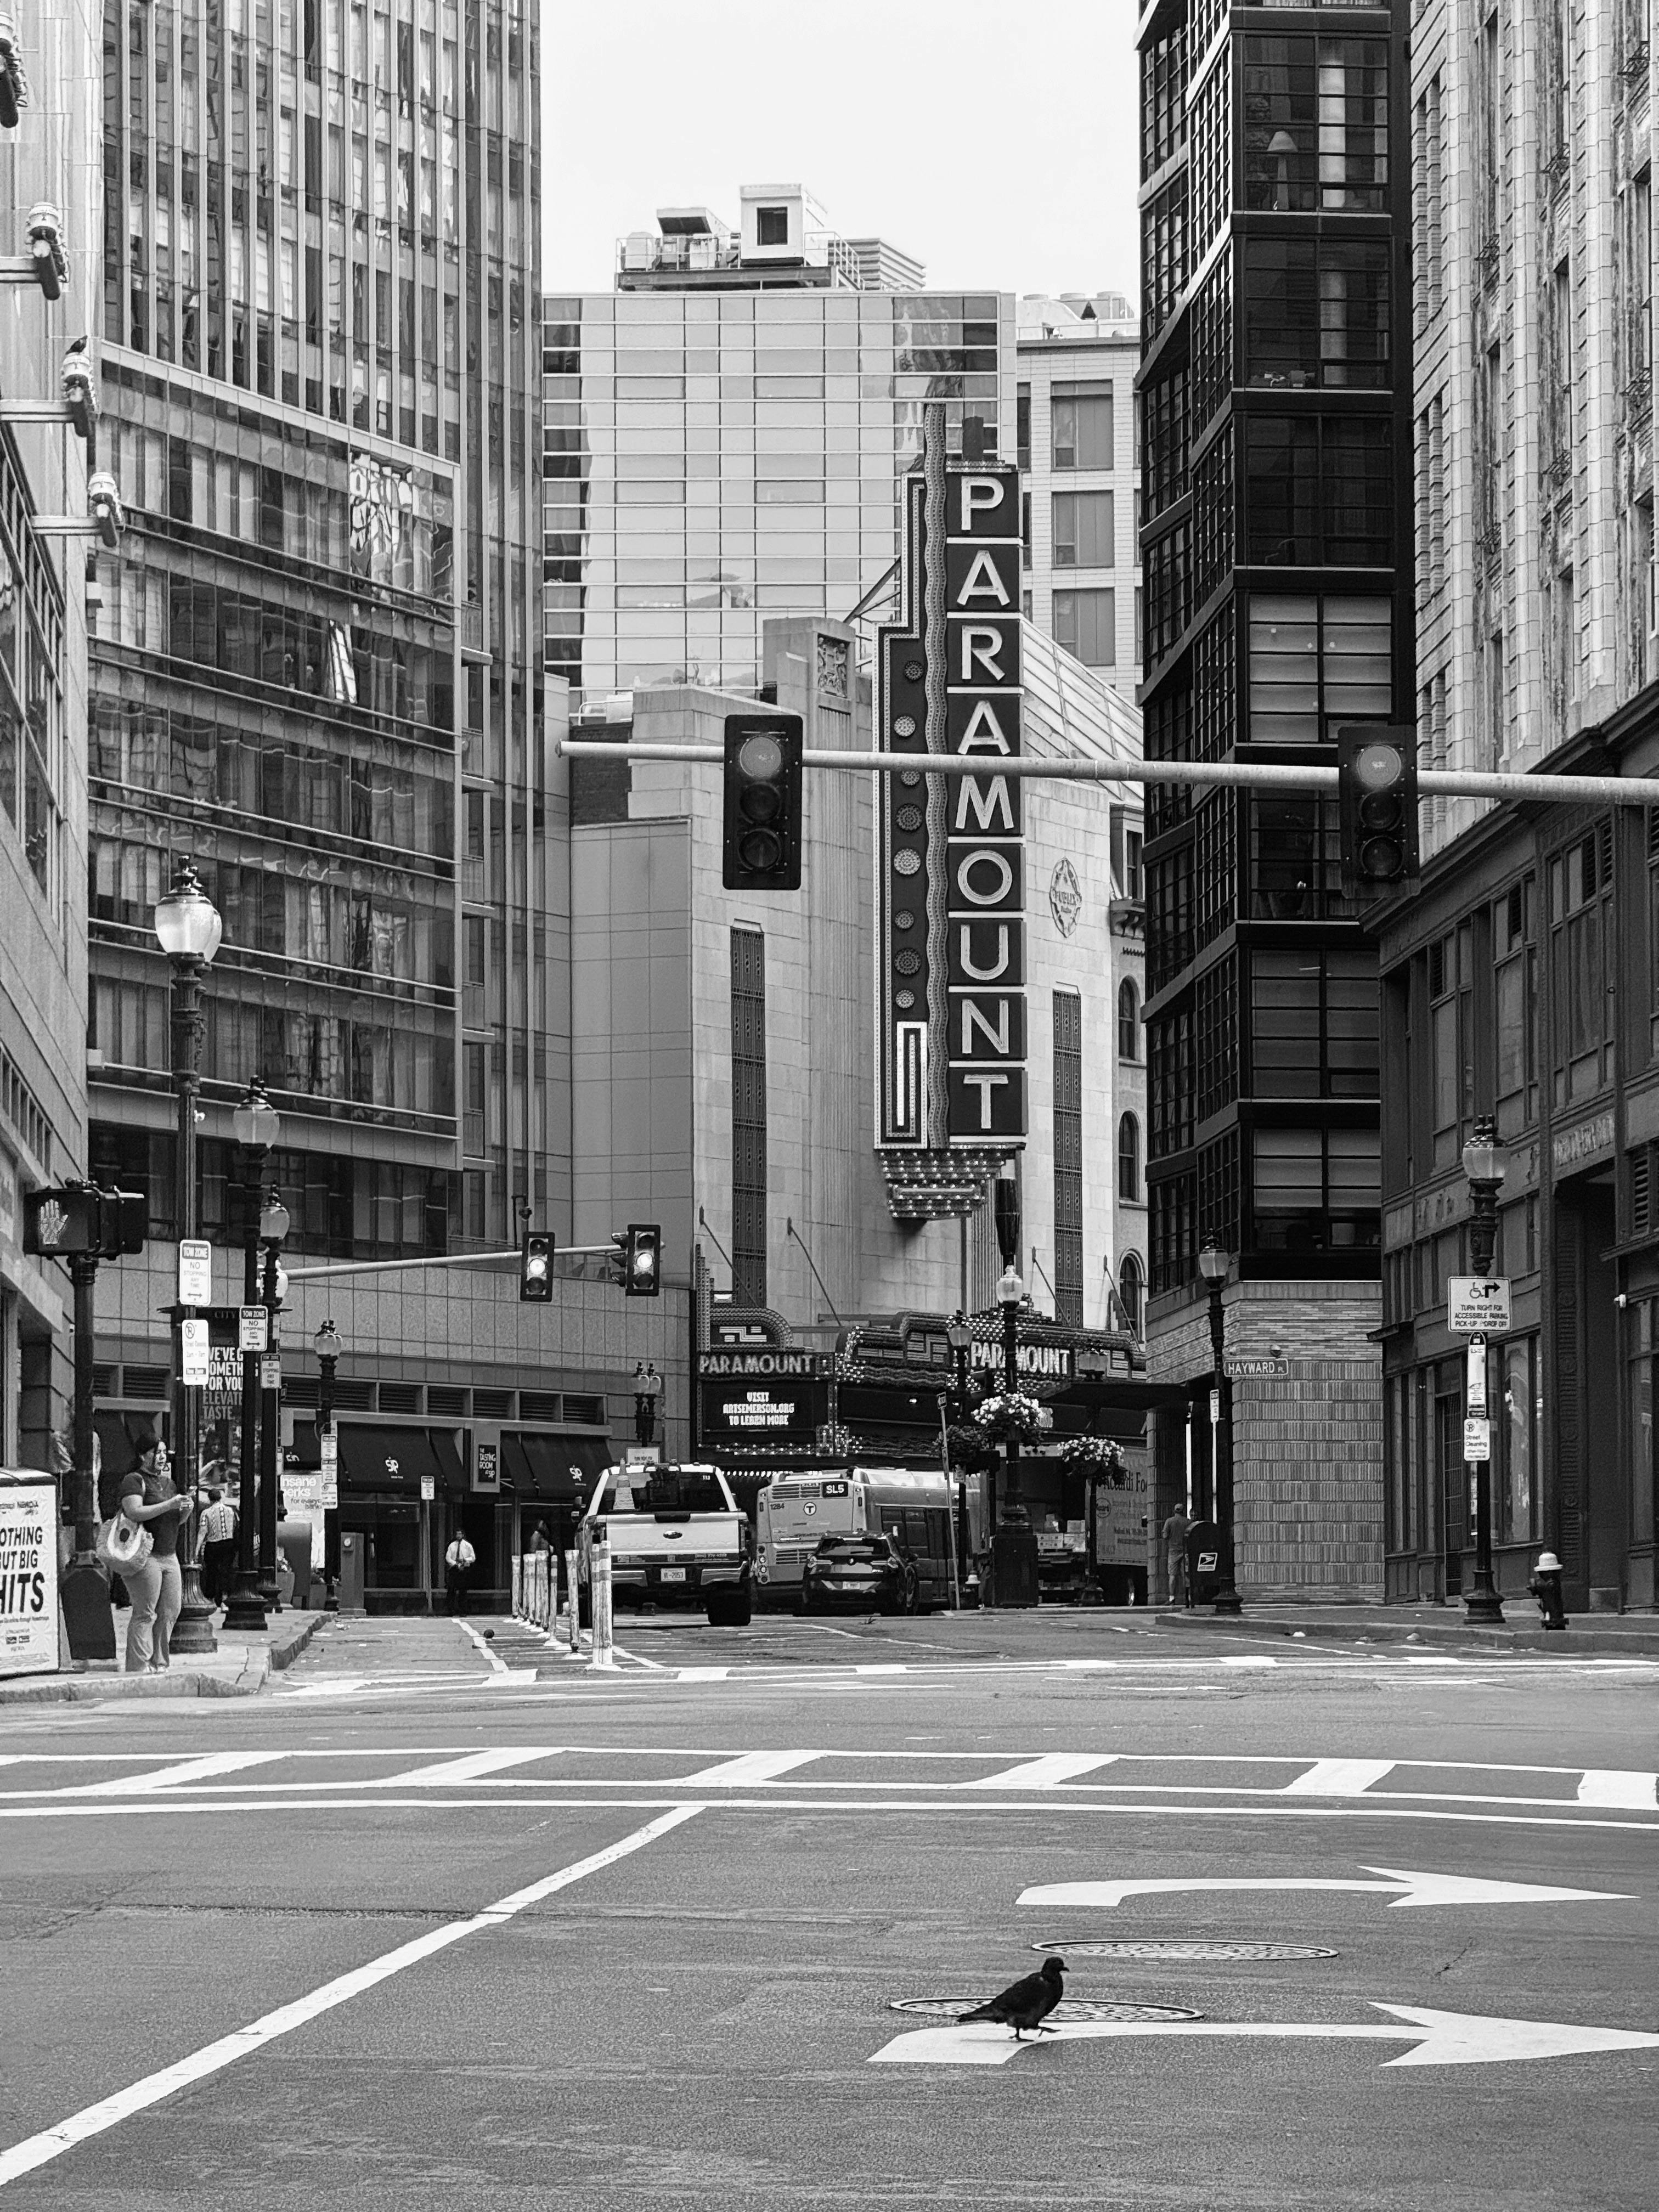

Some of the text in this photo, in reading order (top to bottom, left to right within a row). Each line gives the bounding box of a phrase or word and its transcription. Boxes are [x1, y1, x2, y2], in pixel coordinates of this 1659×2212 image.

[956, 476, 1014, 1130] PARAMOUNT
[183, 1246, 208, 1259] TOW ZONE
[970, 1341, 1070, 1374] PARMOUNT
[699, 1355, 812, 1373] PARAMOUNT
[1228, 1362, 1275, 1374] HAYWARD
[747, 1392, 769, 1402] VISIT
[723, 1403, 794, 1414] ARTSEMERSON.ORG
[729, 1415, 789, 1425] TO LEARN MORE
[826, 1484, 844, 1494] SL5
[0, 1550, 38, 1570] UT BIG
